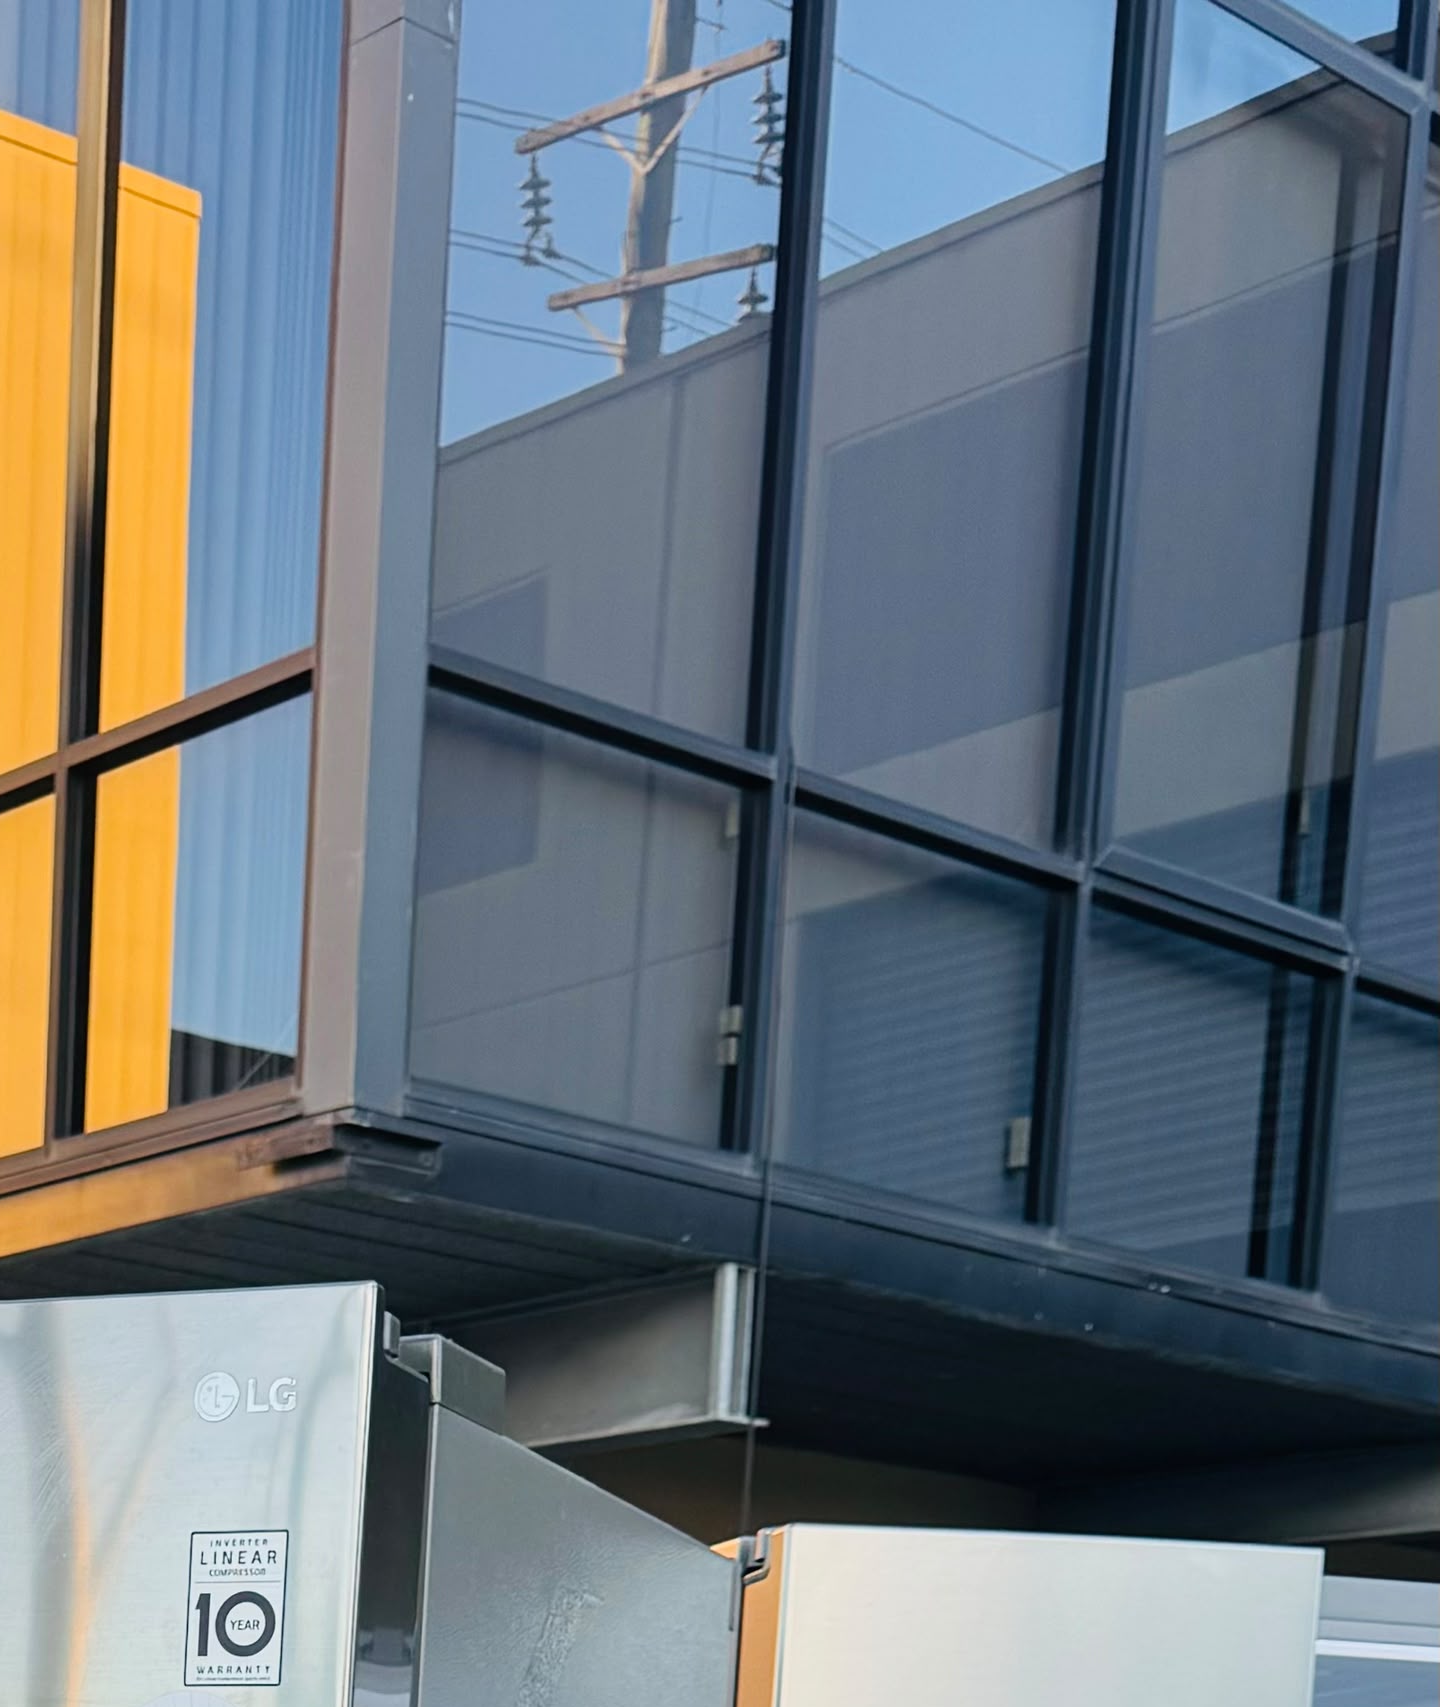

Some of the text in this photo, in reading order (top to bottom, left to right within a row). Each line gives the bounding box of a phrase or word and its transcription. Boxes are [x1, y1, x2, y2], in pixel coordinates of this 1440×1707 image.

[245, 1376, 297, 1414] LG
[209, 1537, 269, 1548] INVERTER
[199, 1549, 278, 1566] LINEAR
[208, 1567, 267, 1578] COMPRESSOR
[194, 1590, 277, 1658] 10
[229, 1619, 261, 1631] YEAR
[195, 1664, 272, 1675] WARRANTY
